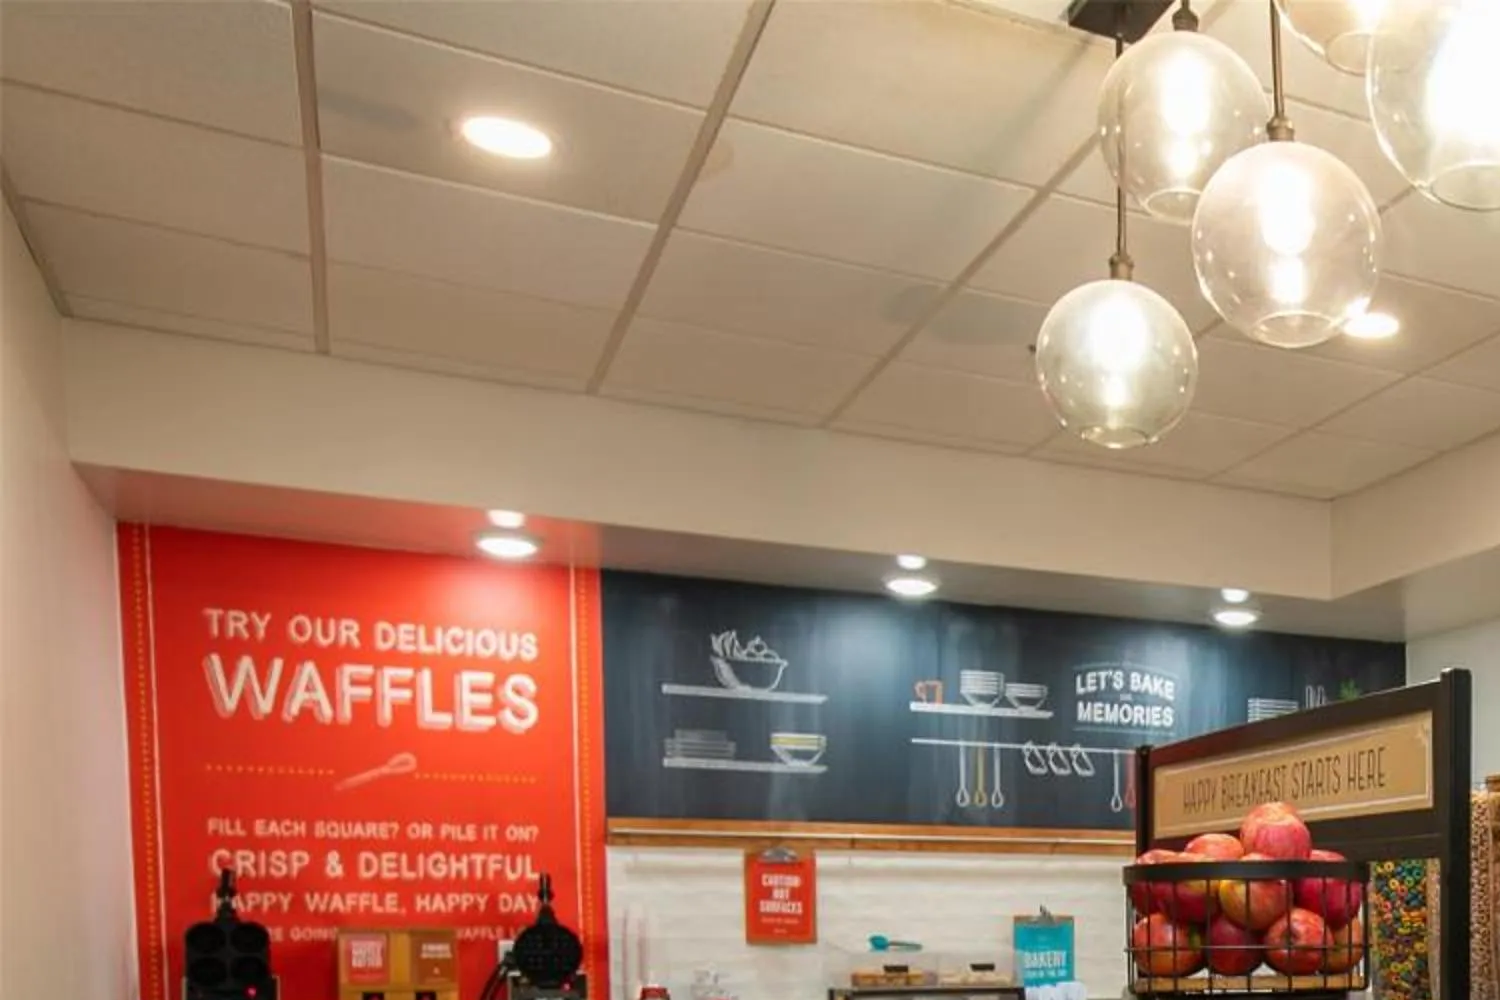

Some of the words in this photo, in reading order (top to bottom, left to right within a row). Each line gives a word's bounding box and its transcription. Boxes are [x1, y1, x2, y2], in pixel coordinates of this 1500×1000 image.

[202, 608, 272, 640] TRY
[288, 615, 361, 648] OUR
[374, 621, 539, 661] DELICIOUS
[202, 653, 539, 734] WAFFLES
[1075, 669, 1124, 695] LET'S
[1130, 671, 1175, 700] BAKE
[1077, 701, 1175, 727] MEMORIES
[1183, 776, 1217, 815] HAPPY
[1221, 765, 1288, 811] BREAKFAST
[1291, 755, 1341, 800] STARTS
[1347, 747, 1387, 790] HERE
[207, 818, 246, 837] FILL
[254, 819, 306, 838] EACH
[314, 821, 400, 840] SQUARE?
[406, 822, 434, 841] OR
[439, 823, 478, 842] PILE
[483, 825, 498, 841] IT
[505, 825, 539, 842] ON?
[209, 849, 311, 879] CRISP
[325, 852, 344, 879] &
[358, 851, 540, 880] DELIGHTFUL
[416, 893, 490, 913] HAPPY
[1024, 951, 1067, 968] BAKERY
